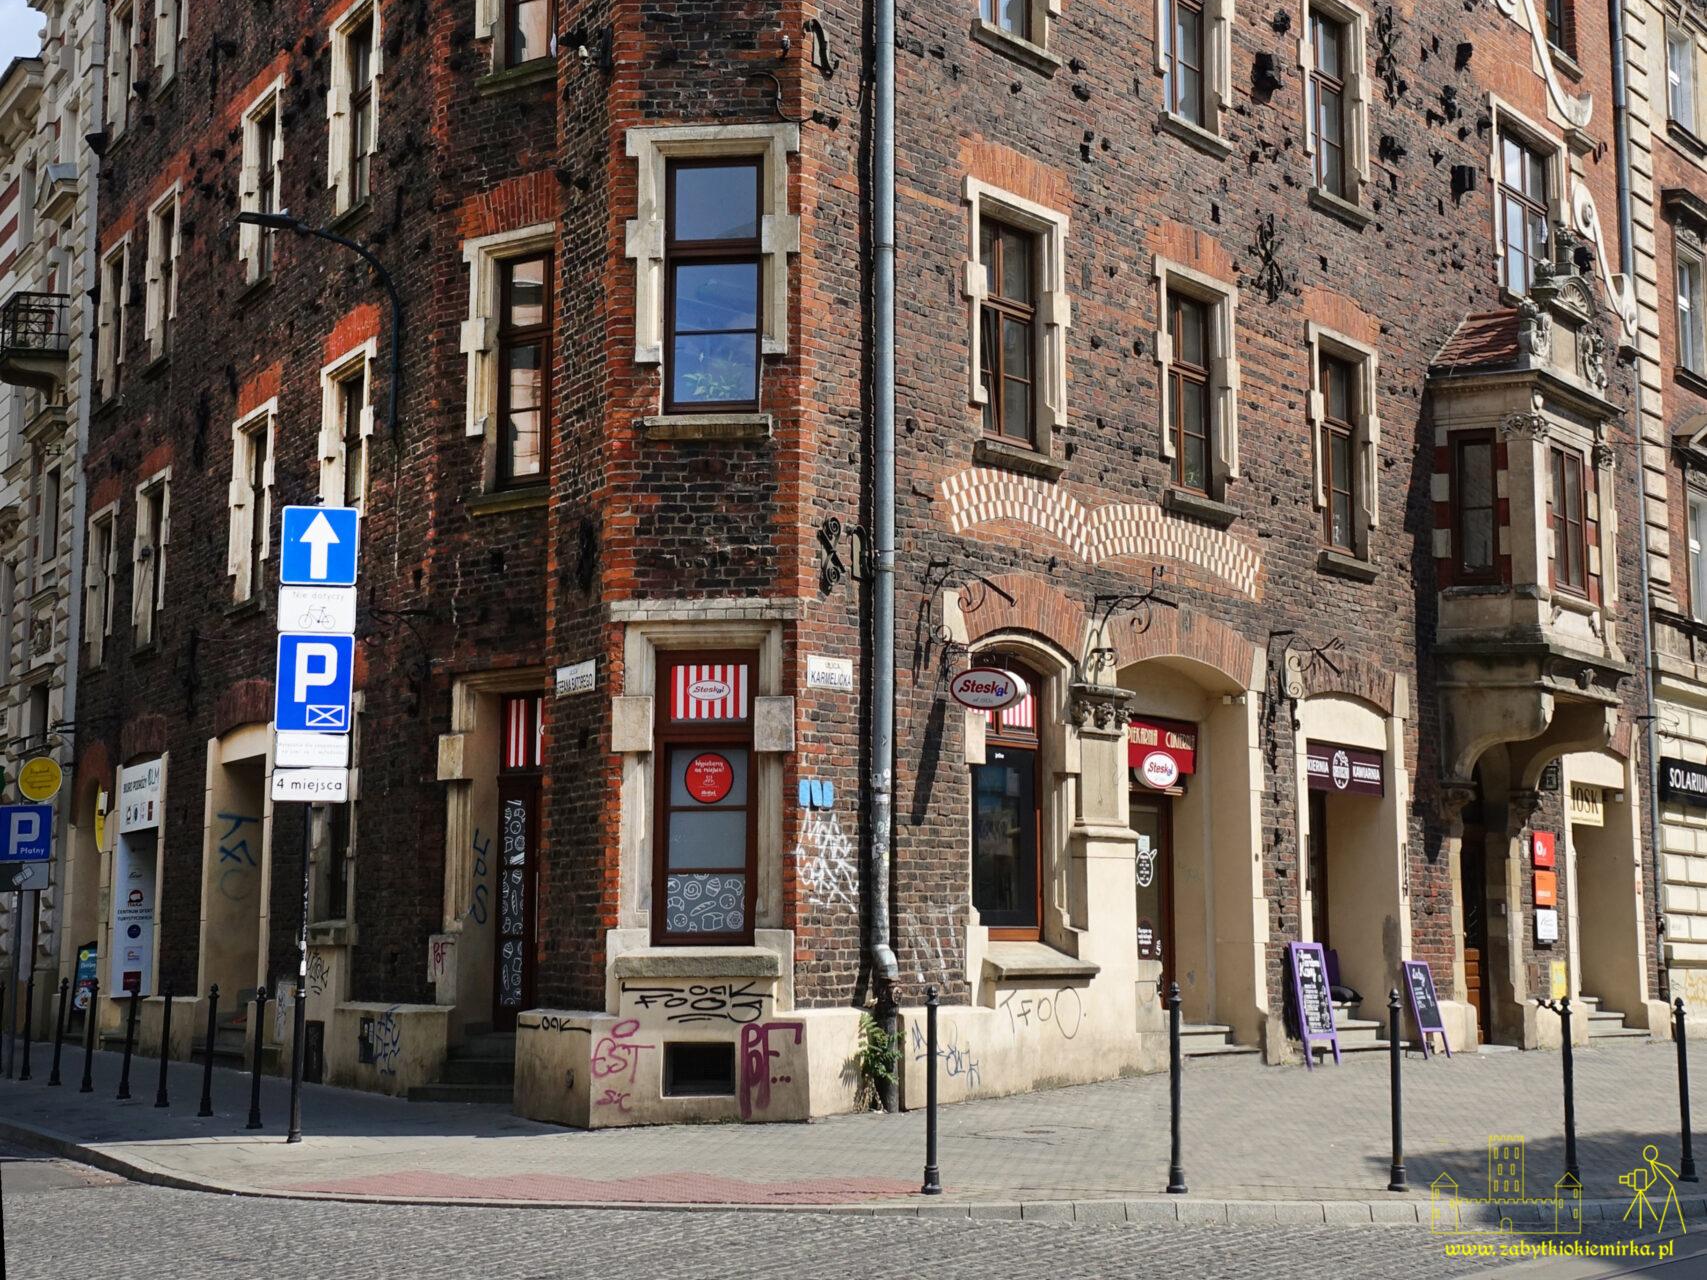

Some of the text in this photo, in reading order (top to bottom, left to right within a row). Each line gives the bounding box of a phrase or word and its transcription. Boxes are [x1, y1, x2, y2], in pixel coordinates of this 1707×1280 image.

[294, 642, 338, 703] P
[811, 671, 852, 687] KARMELICKA
[694, 685, 725, 694] Steskal
[958, 680, 1009, 697] Steskal
[1147, 761, 1174, 777] Steskal
[276, 778, 342, 793] 4 miejsca
[1572, 786, 1599, 814] IOSK
[9, 811, 41, 855] P
